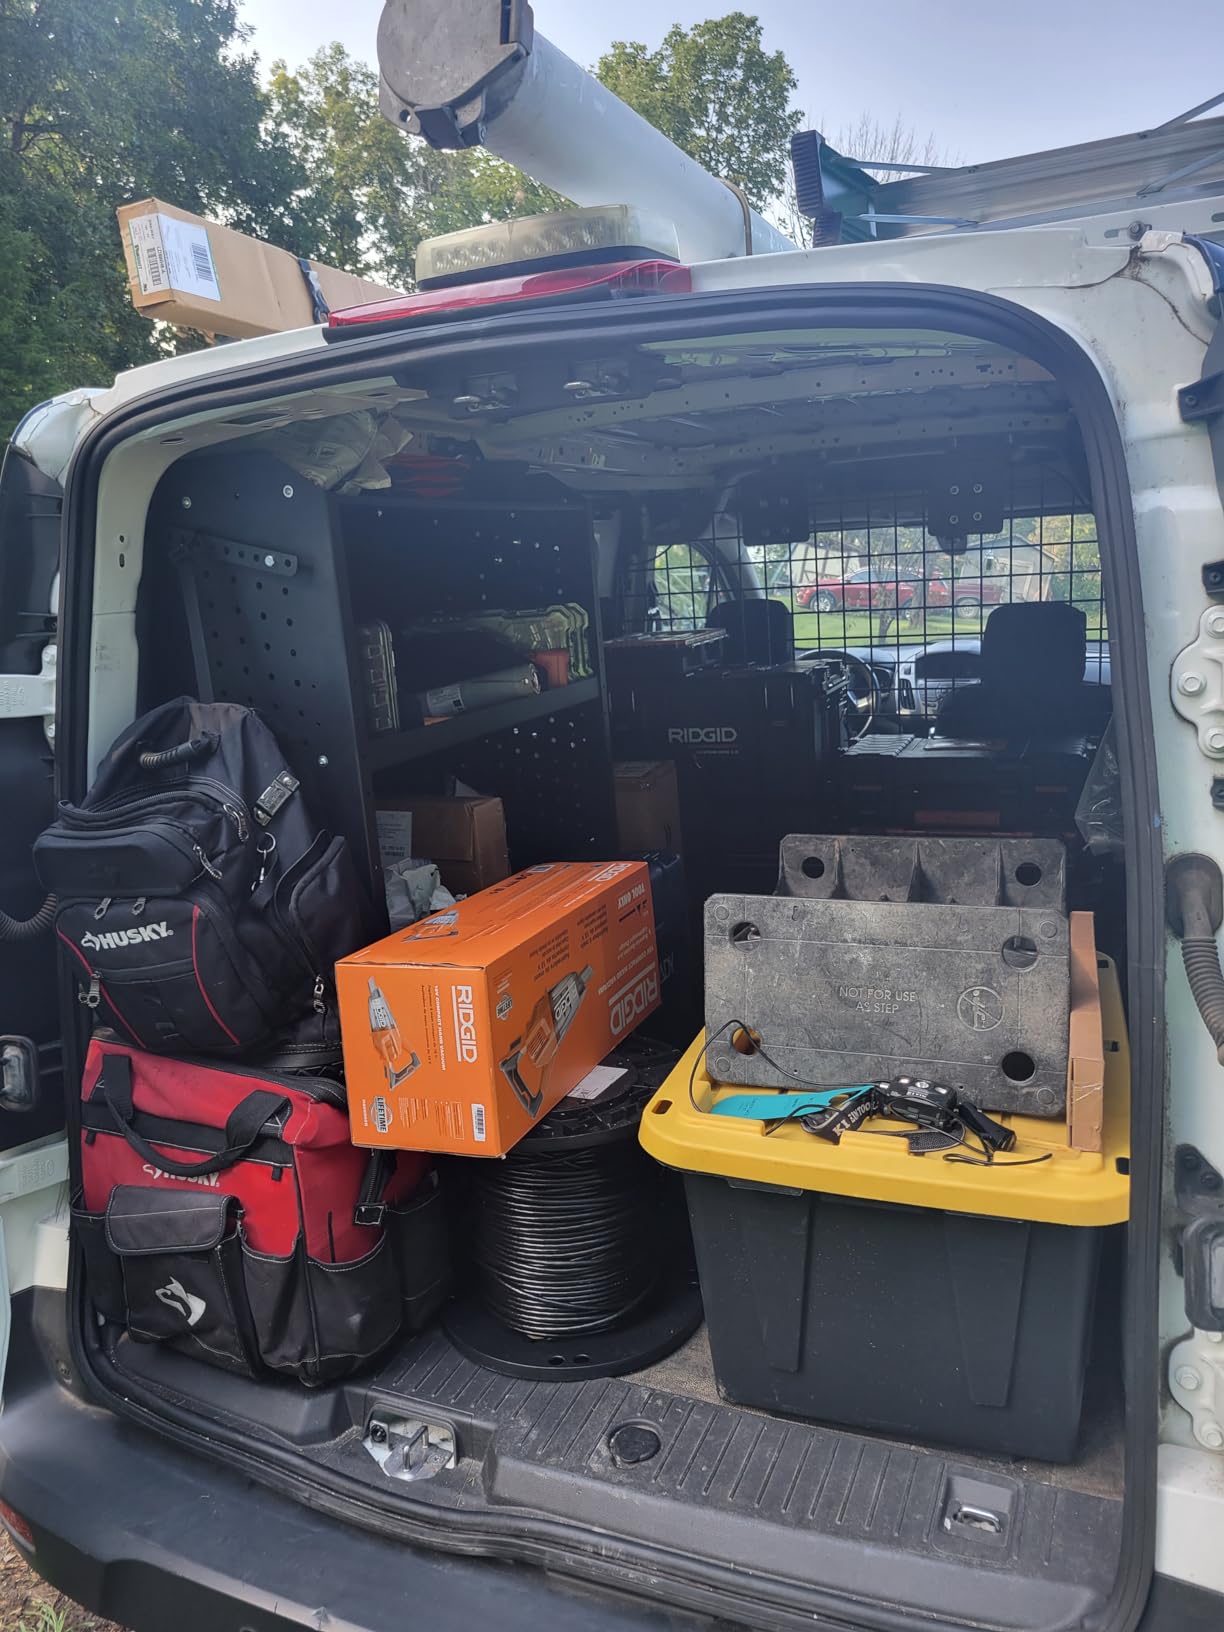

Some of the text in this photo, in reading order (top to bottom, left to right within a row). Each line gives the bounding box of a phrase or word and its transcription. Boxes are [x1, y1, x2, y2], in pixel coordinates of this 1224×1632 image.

[668, 727, 737, 743] RIDGID
[97, 921, 168, 949] HUSKY
[610, 971, 657, 1036] RIDGID
[839, 986, 916, 1002] NOT FOR USE
[855, 1001, 899, 1014] AS STEP
[456, 985, 478, 1063] RIDGID
[377, 1097, 387, 1132] LIFETIME
